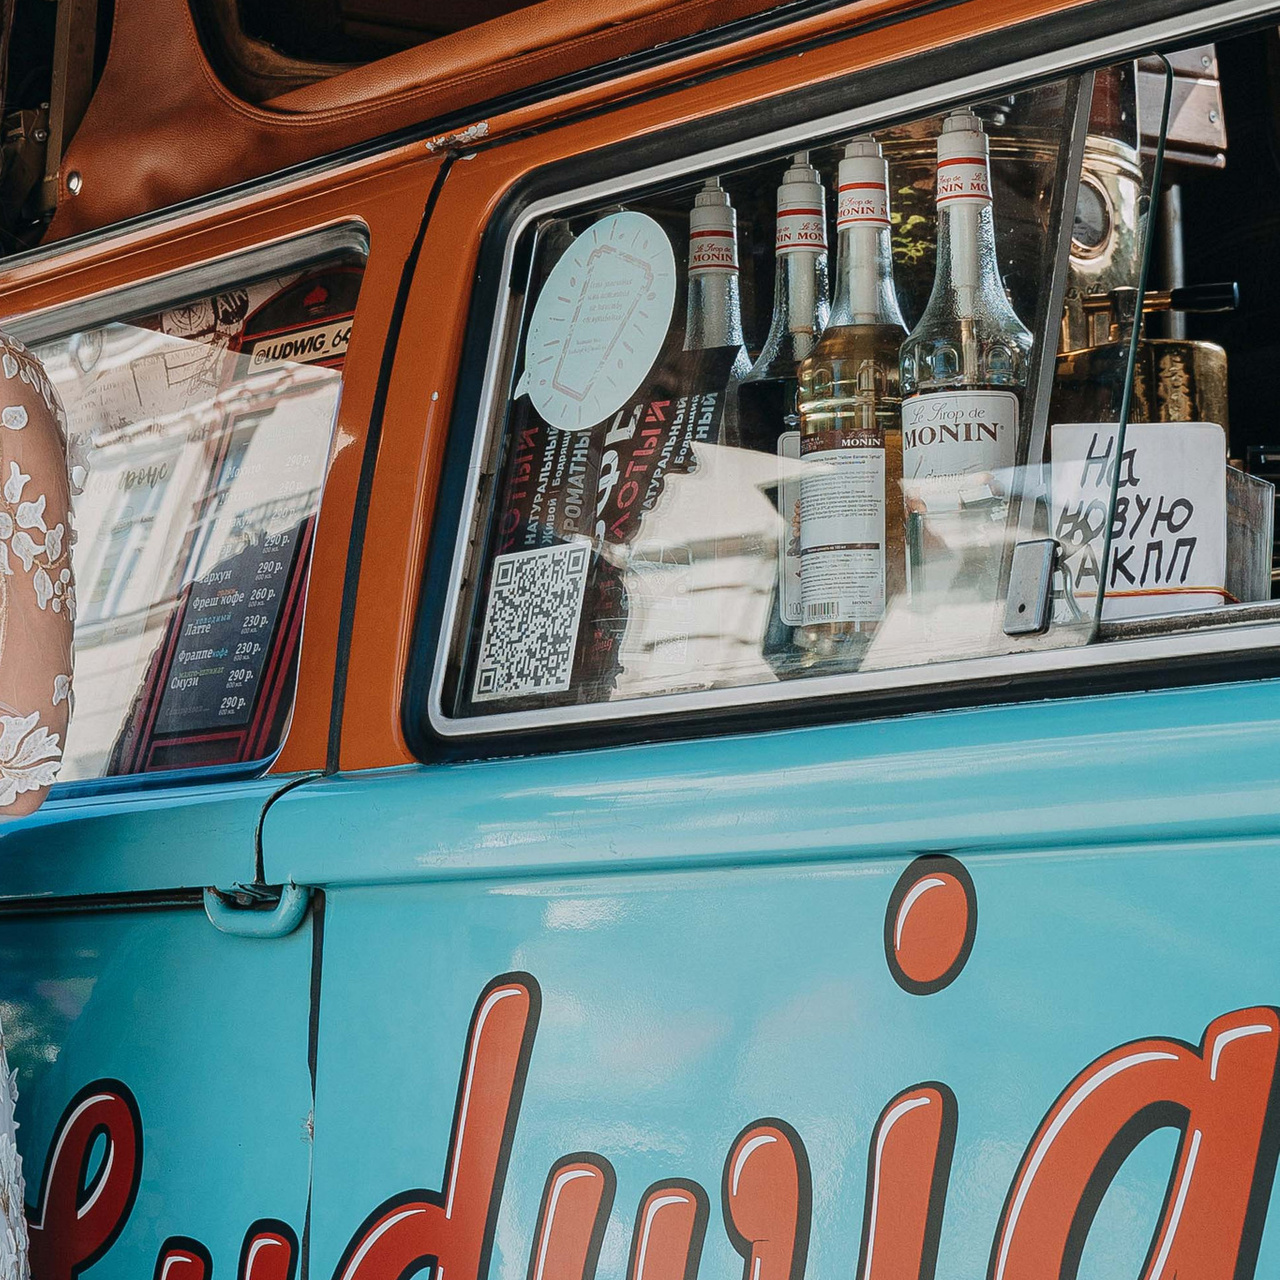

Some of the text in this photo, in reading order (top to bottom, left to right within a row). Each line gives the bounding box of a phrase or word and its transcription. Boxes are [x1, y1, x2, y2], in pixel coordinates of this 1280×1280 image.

[838, 207, 875, 218] MONIN
[706, 242, 723, 254] Sirop
[797, 232, 824, 241] MON
[693, 253, 733, 263] MONIN
[909, 402, 985, 425] Le Sirop de
[841, 438, 881, 447] MONIN
[904, 422, 999, 451] MONIN
[638, 396, 689, 519] АТУРАЛЬНЫЙ
[1080, 433, 1140, 489] На
[524, 426, 559, 545] НАТУРАЛЬНЫЙ
[541, 430, 571, 545] Живой Бодрящи
[562, 431, 593, 542] РОМАТНЫ
[264, 535, 282, 547] 290
[257, 560, 274, 574] 290
[192, 596, 218, 611] Фреш
[220, 590, 245, 607] кофе
[250, 587, 266, 601] 260
[184, 622, 211, 637] Латте
[242, 614, 259, 628] 230
[178, 649, 213, 664] Фраппе
[235, 641, 252, 655] 230
[170, 676, 199, 691] Смузи
[228, 669, 245, 682] 290
[220, 696, 237, 709] 290
